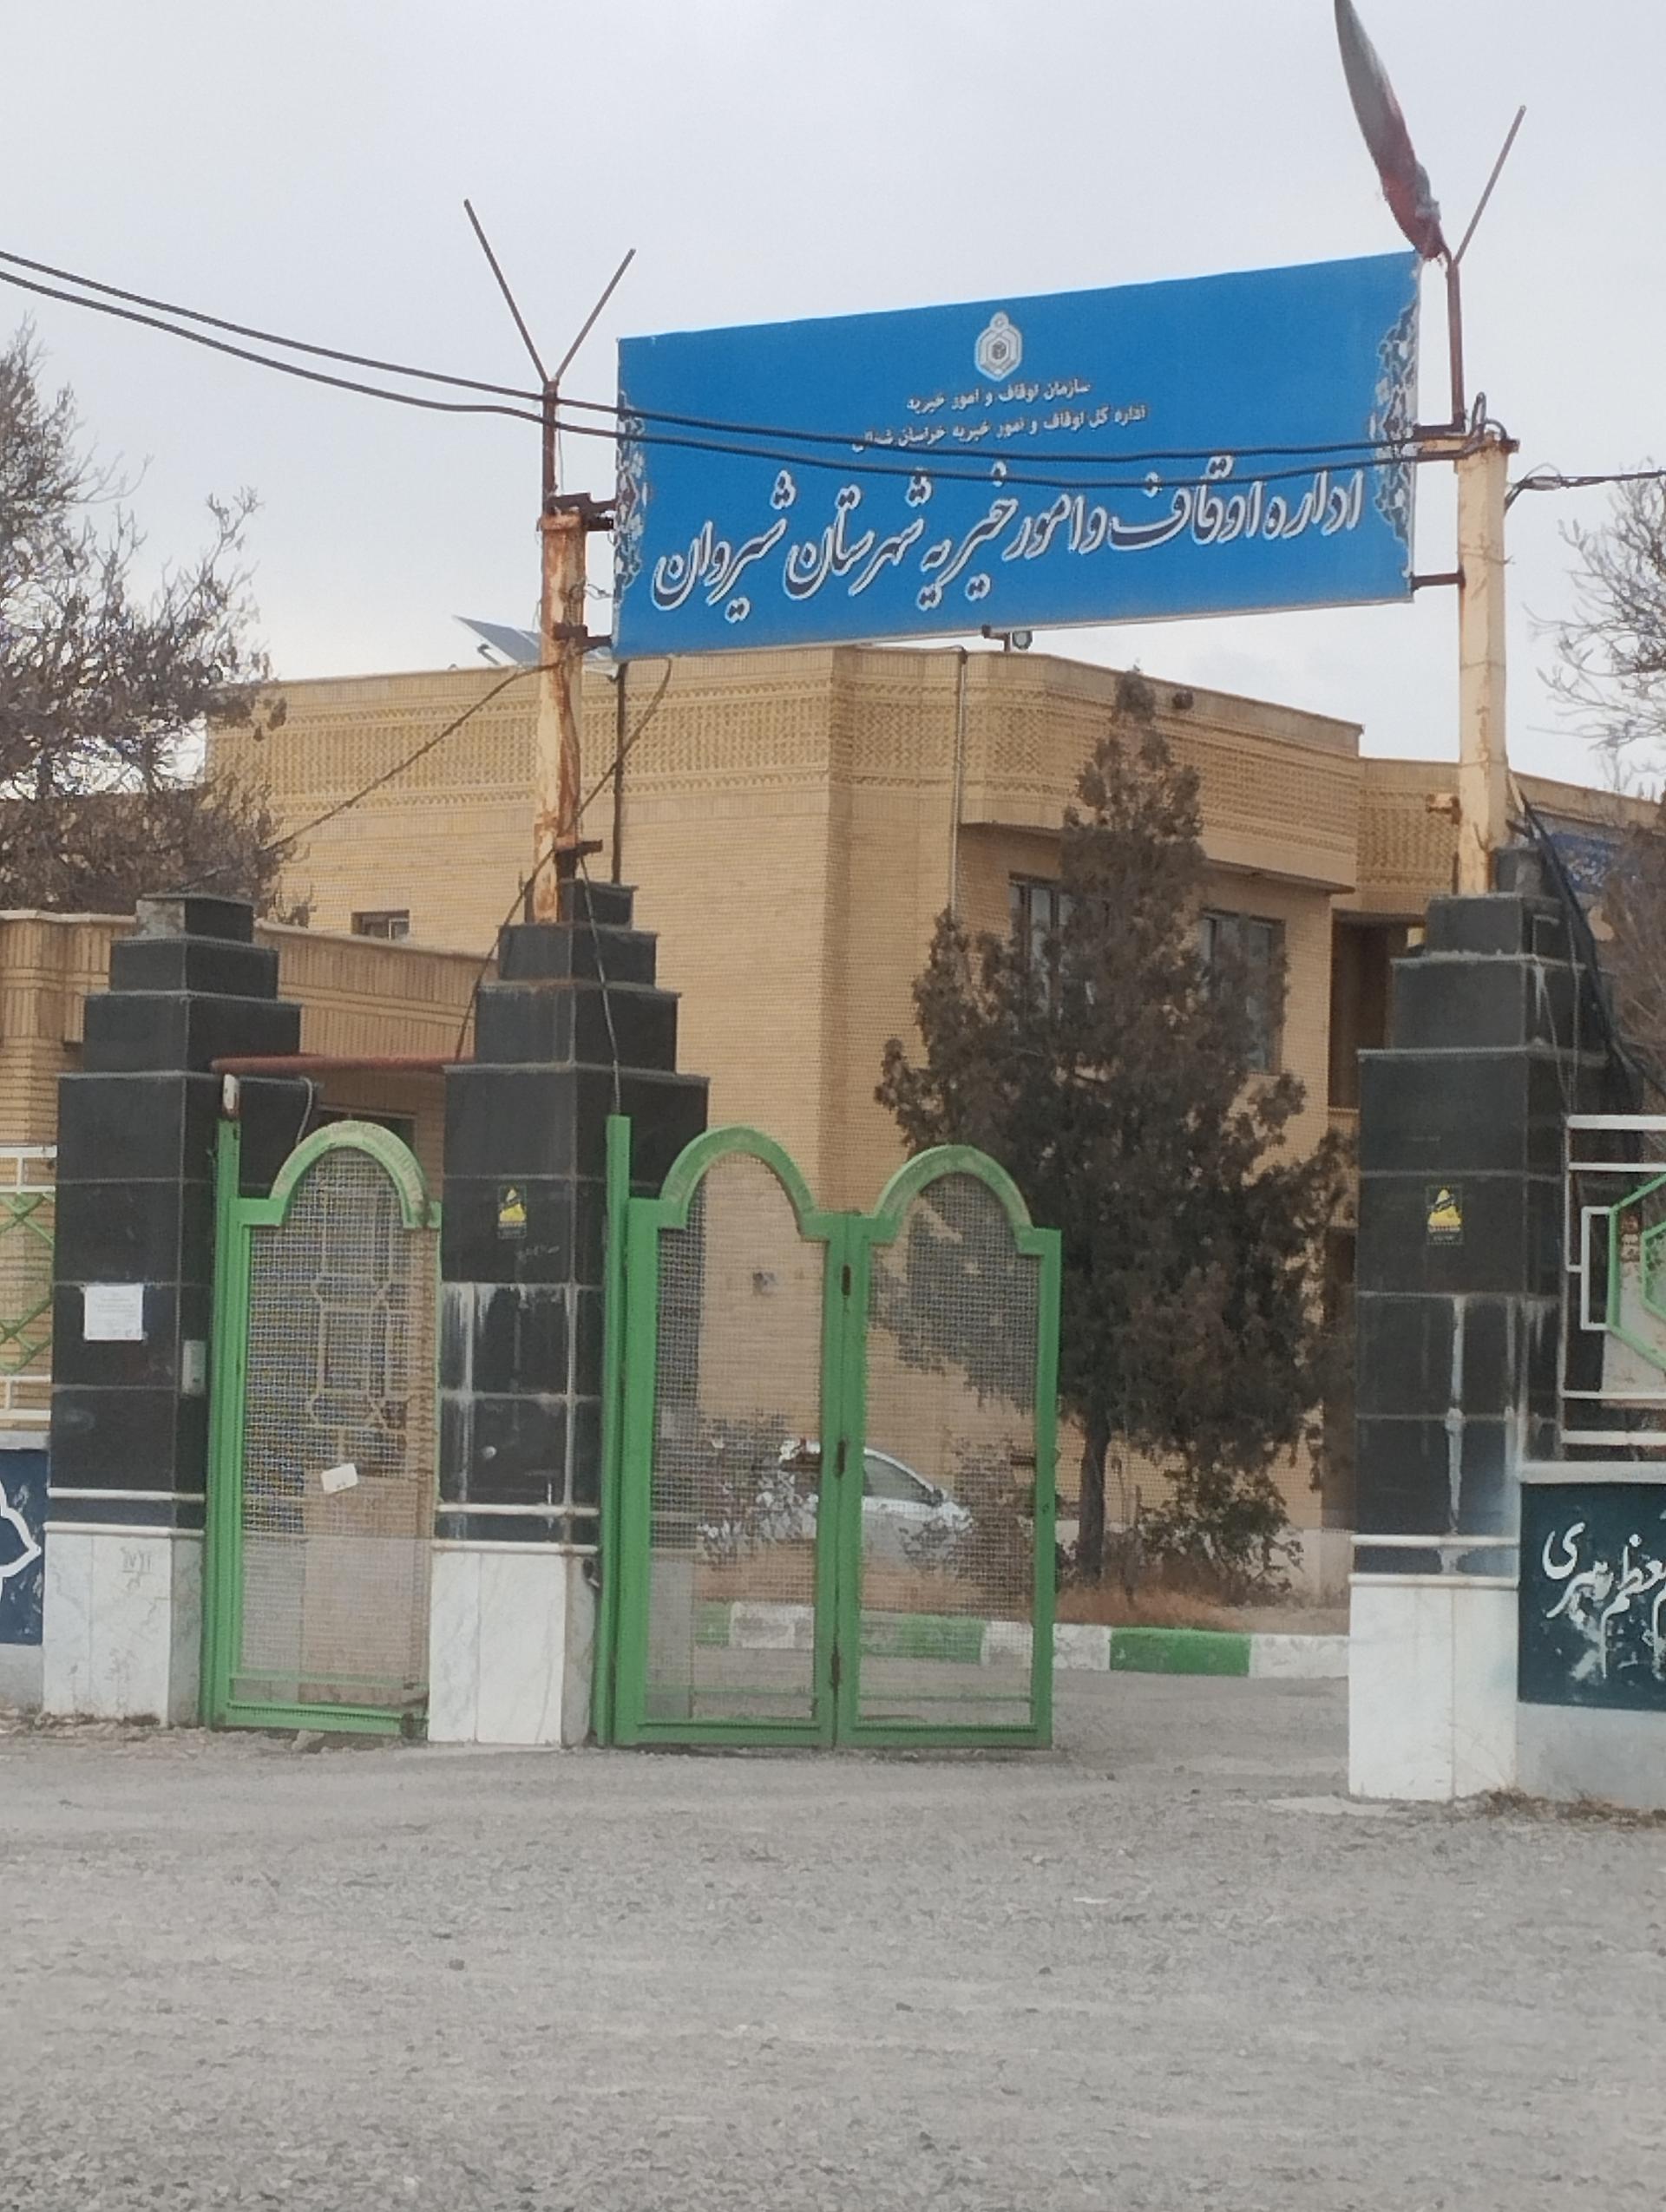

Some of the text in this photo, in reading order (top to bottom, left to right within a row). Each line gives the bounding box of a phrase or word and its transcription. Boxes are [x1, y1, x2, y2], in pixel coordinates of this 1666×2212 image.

[906, 378, 1090, 415] سازمان اوقاف و امور خیریه
[1043, 410, 1085, 431] اوقاف
[1089, 406, 1110, 429] کل
[1114, 403, 1146, 425] اداره
[897, 425, 946, 447] خراسان
[952, 420, 991, 442] خیریه
[996, 416, 1025, 437] امور
[1028, 420, 1038, 435] و
[651, 455, 1365, 624] اداره اوقاف و امور خیریه شهرستان شیروان
